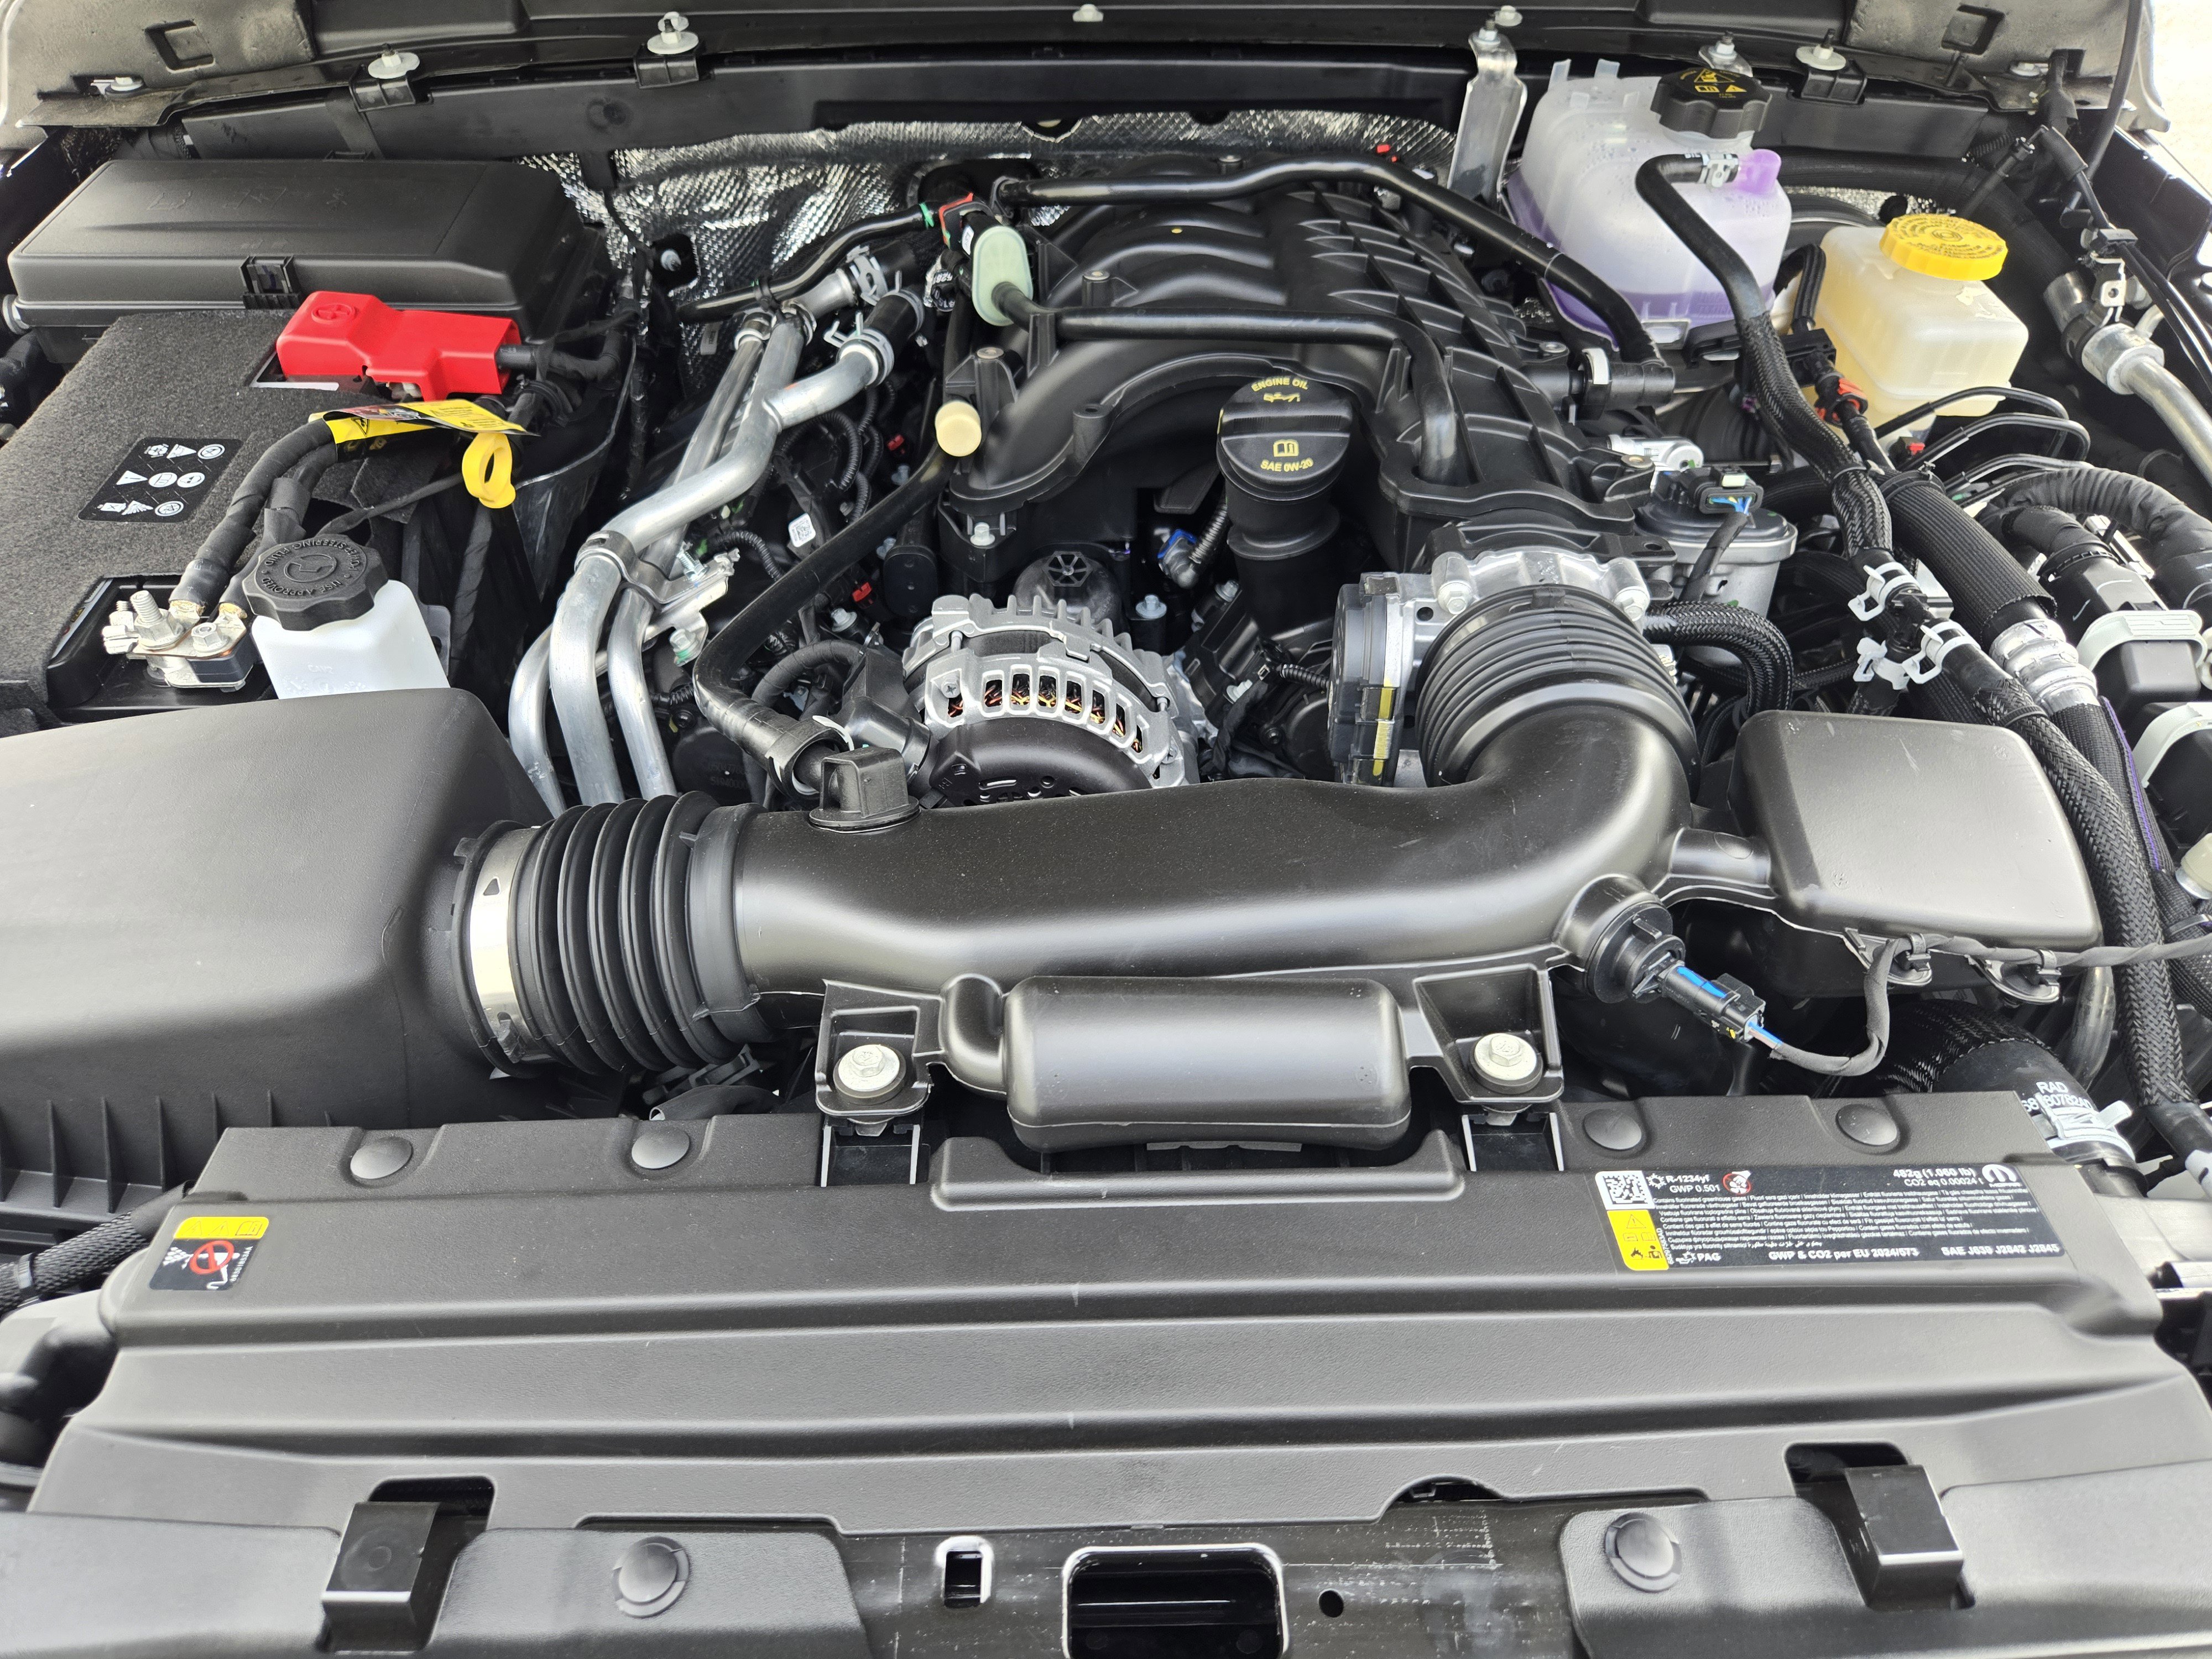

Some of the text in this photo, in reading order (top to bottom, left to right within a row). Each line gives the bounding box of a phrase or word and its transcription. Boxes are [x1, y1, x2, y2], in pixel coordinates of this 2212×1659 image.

[1251, 377, 1310, 392] ENGINE OIL
[1260, 457, 1314, 472] SAE 0W-20
[264, 538, 361, 571] POWER STEERING FLUID
[262, 577, 342, 596] USE APPROVED
[2036, 1081, 2069, 1094] RAD
[1666, 1174, 1710, 1184] R-1234yf
[1893, 1169, 1922, 1179] 482g
[1958, 1168, 1976, 1177] lb)
[1695, 1184, 1721, 1193] 0.501
[1768, 1251, 1795, 1260] GWP
[1797, 1250, 1807, 1259] &
[1808, 1250, 1832, 1259] CO2
[1833, 1251, 1852, 1260] per
[1852, 1249, 1870, 1258] EU
[1941, 1244, 2060, 1256] SAE J639 J2842 J2845
[1697, 1253, 1721, 1261] PAG
